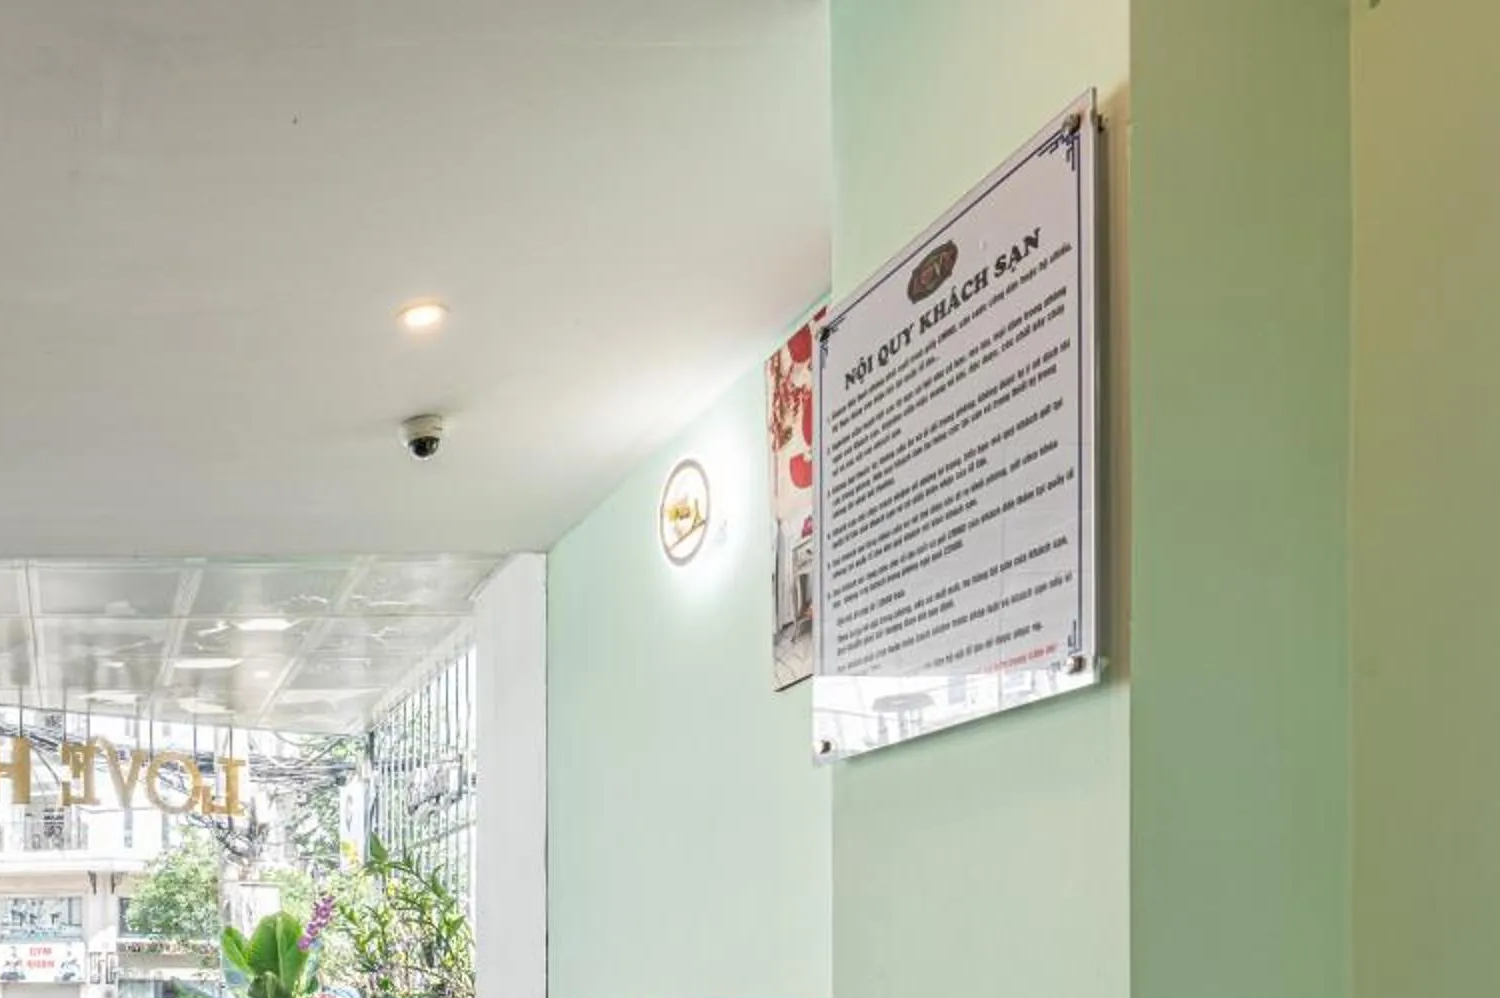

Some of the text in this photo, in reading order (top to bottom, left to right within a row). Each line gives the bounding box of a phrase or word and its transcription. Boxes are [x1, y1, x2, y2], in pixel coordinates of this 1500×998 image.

[844, 356, 874, 391] NỘI
[877, 322, 915, 366] QUY
[919, 266, 990, 334] KHÁCH
[994, 227, 1042, 279] SẠN
